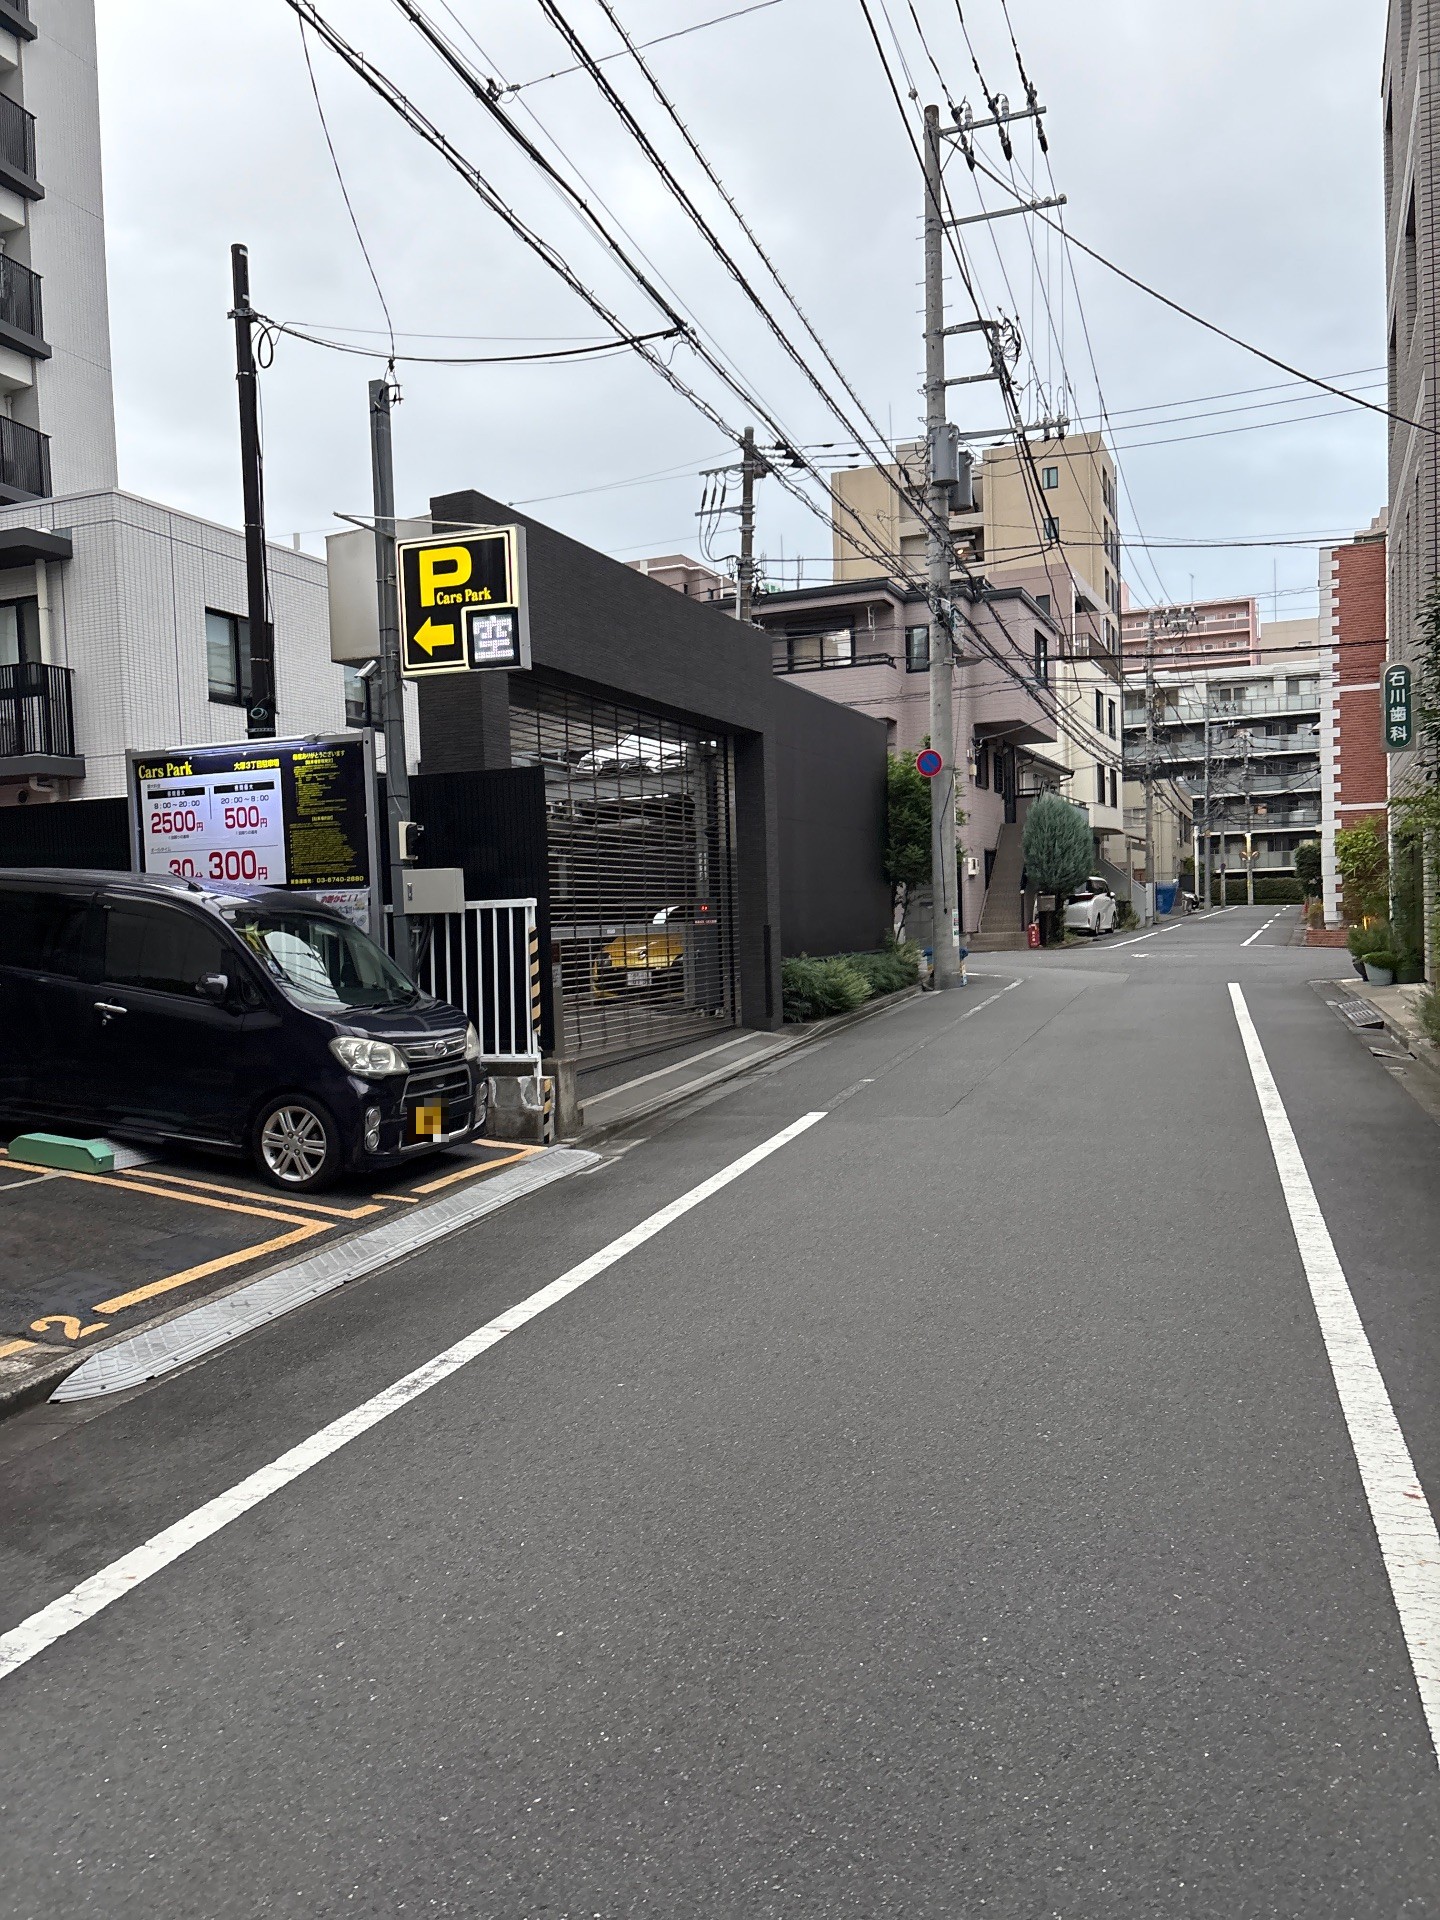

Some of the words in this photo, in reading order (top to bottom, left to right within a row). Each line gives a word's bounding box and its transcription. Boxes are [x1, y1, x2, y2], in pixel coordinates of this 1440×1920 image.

[419, 546, 472, 607] P
[436, 592, 463, 605] Cars
[464, 587, 492, 602] Park
[473, 615, 514, 660] 空
[1389, 671, 1408, 742] 石川歯科
[139, 765, 164, 779] Cars
[166, 761, 193, 776] Park
[151, 810, 204, 834] 2500円
[224, 806, 268, 829] 500円
[208, 850, 268, 880] 300円
[30, 1315, 110, 1340] 2
